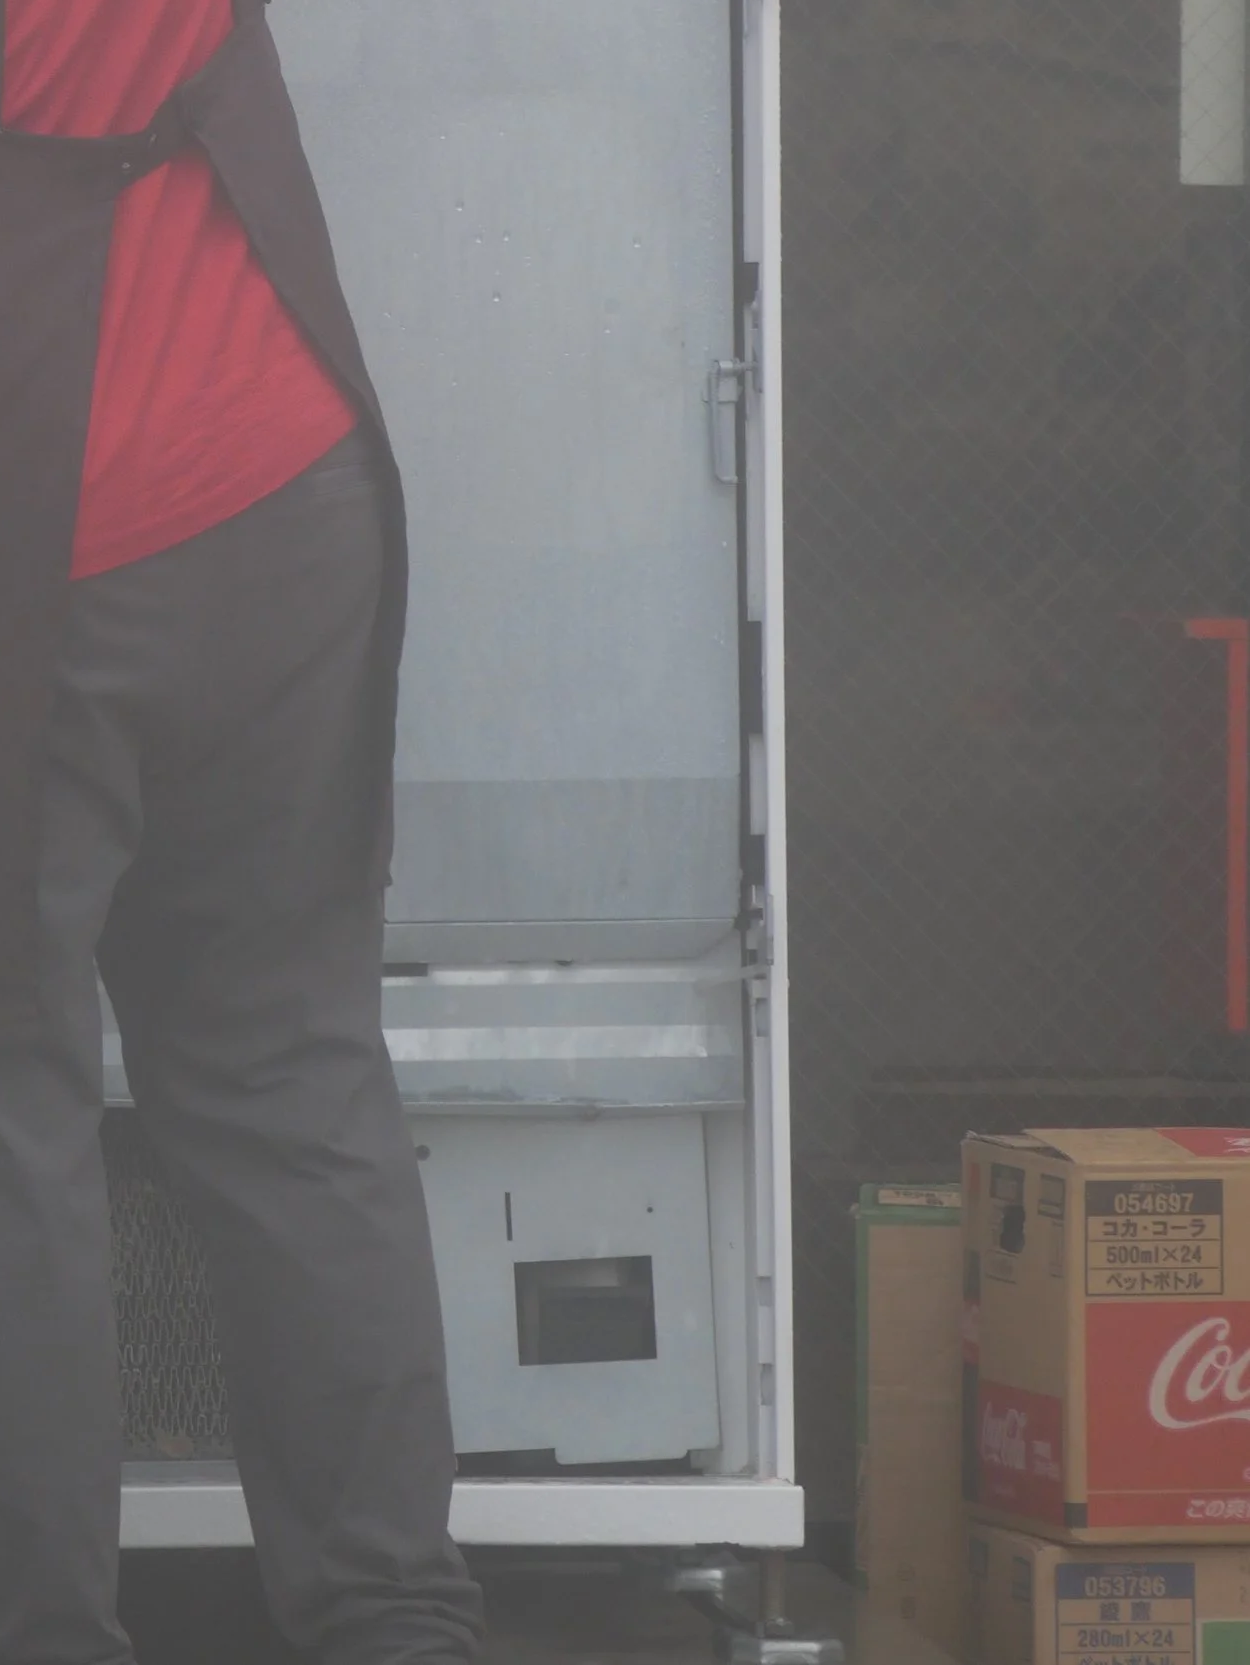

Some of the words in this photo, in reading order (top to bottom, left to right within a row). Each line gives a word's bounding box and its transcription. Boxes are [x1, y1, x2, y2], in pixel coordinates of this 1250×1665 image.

[1113, 1192, 1195, 1214] 054697
[1102, 1218, 1206, 1238] コカ・コーラ
[1106, 1271, 1204, 1291] ペットボトル
[1084, 1576, 1167, 1597] 053796
